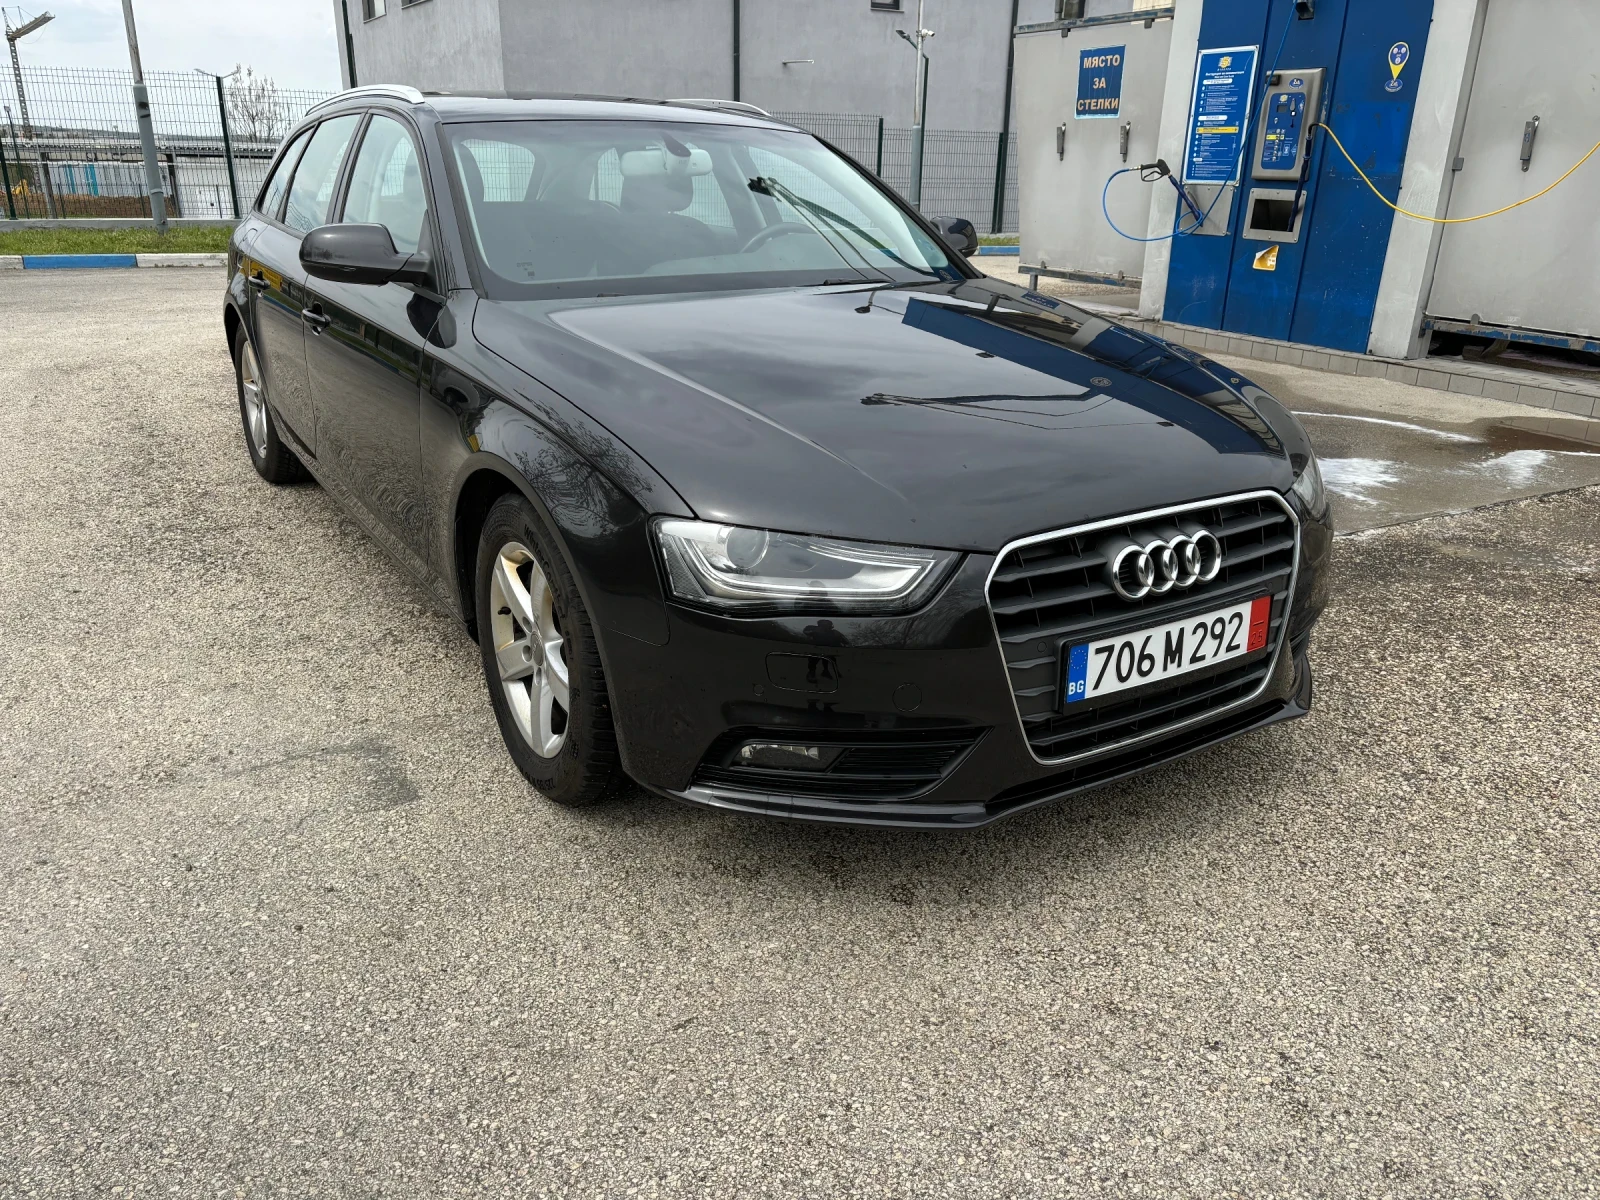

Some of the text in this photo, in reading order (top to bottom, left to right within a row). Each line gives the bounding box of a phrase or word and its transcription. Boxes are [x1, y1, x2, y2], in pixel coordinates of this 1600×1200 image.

[1083, 54, 1121, 69] МЯСТО
[1092, 77, 1107, 89] ЗА
[1077, 97, 1119, 111] СТЕЛКИ
[1068, 680, 1085, 696] BG
